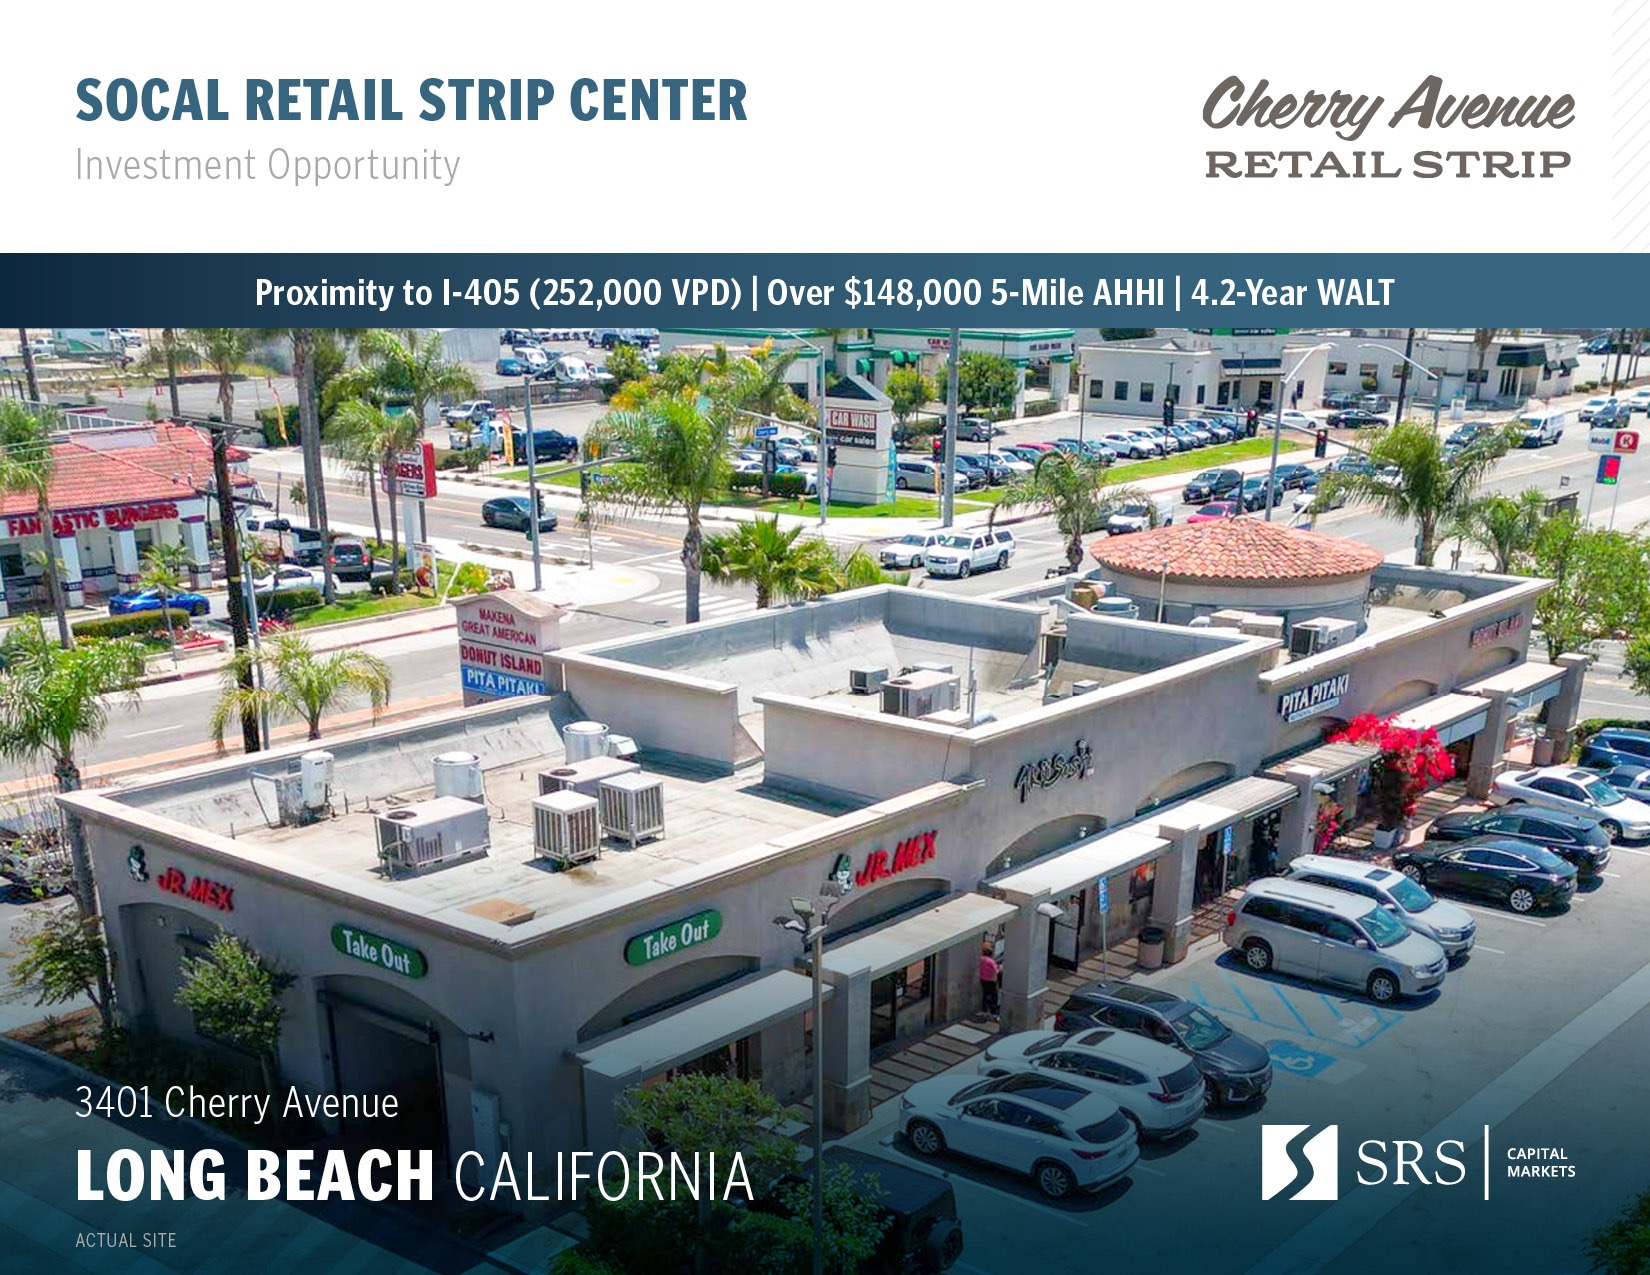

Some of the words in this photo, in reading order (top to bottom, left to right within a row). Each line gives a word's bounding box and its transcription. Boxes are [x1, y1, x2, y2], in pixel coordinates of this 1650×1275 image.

[832, 410, 850, 428] CAR
[850, 412, 876, 430] WASH
[8, 511, 100, 537] FANASTIC
[479, 607, 516, 627] MAKENA
[462, 620, 489, 637] GREAT
[492, 626, 537, 646] AMERICAN
[460, 644, 497, 668] DONUT
[501, 652, 542, 676] ISLAND
[467, 669, 496, 689] PITA
[498, 676, 541, 696] PITAKI
[1281, 687, 1309, 717] PITA
[1310, 673, 1350, 706] PITAKI
[342, 929, 378, 962] Take
[381, 943, 411, 975] Out
[643, 931, 677, 960] Take
[681, 919, 709, 946] Out
